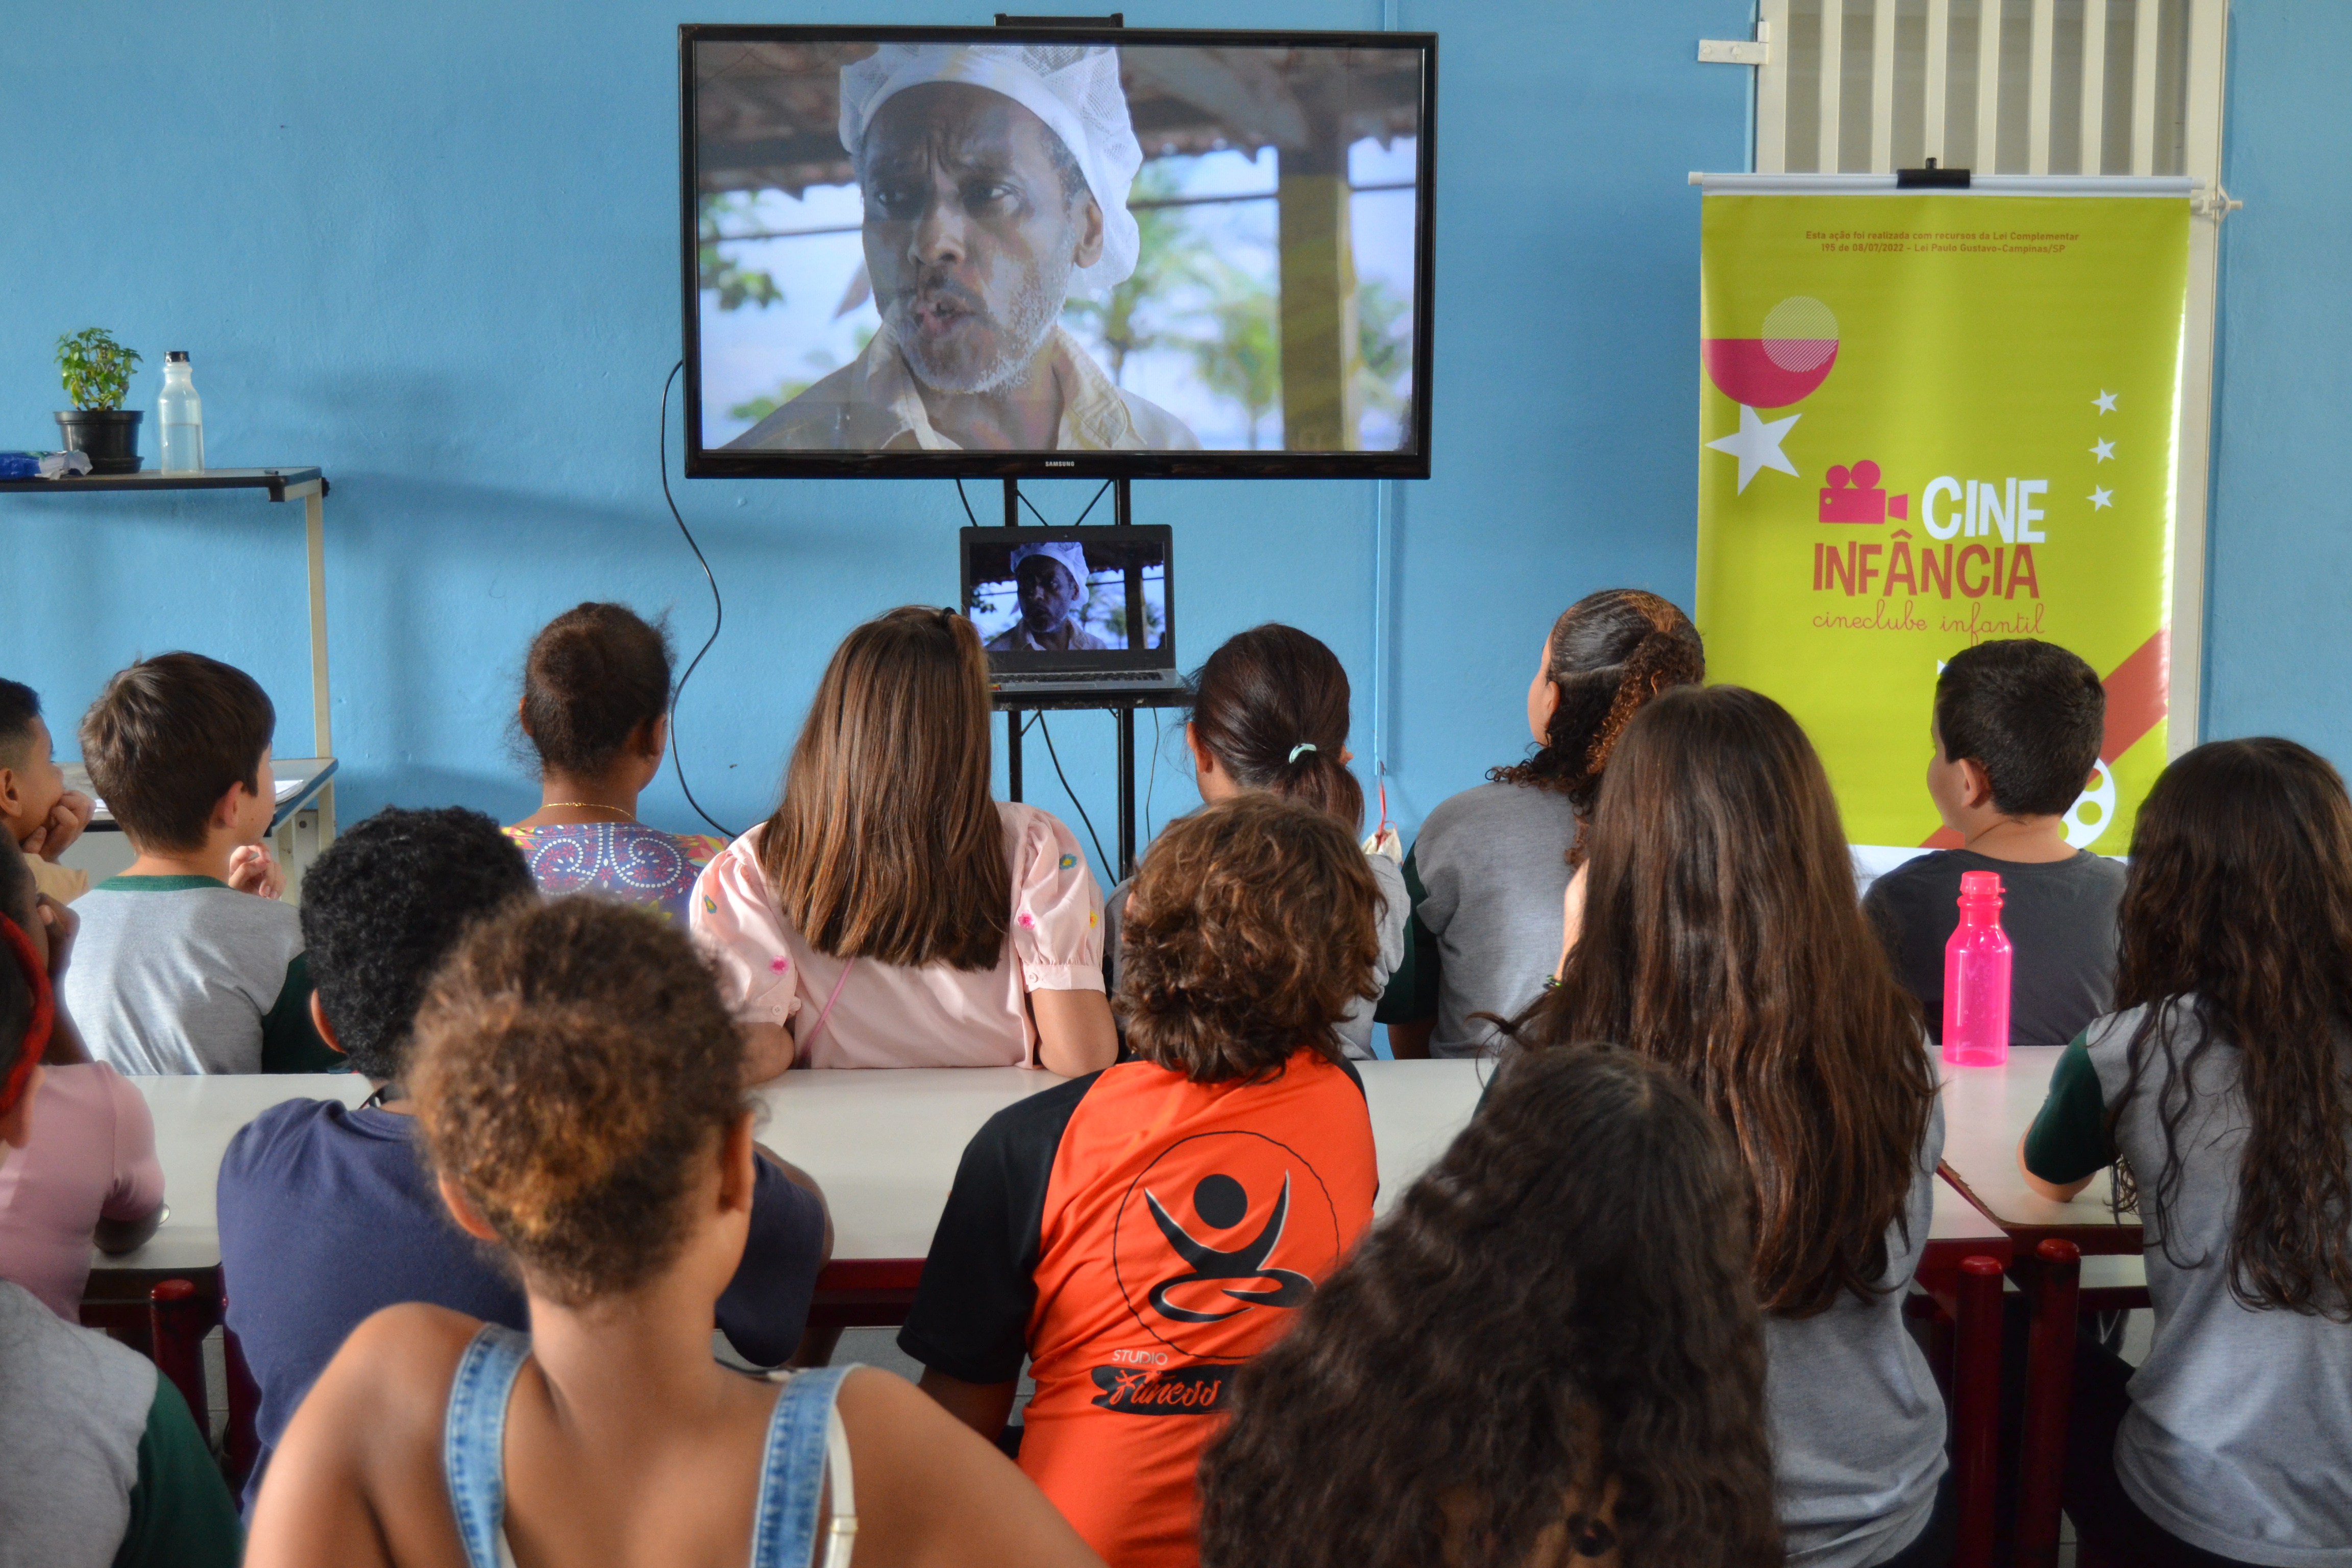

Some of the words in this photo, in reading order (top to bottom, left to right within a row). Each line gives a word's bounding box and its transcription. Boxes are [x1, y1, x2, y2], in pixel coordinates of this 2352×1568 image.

[1806, 231, 1826, 239] Esta
[1829, 231, 1850, 241] ação
[1854, 231, 1865, 239] foi
[1868, 231, 1909, 239] realizada
[1979, 232, 1990, 240] da
[2011, 232, 2079, 241] Complementar
[1853, 243, 1904, 253] 08/07/2022
[1922, 476, 2048, 544] CINE
[1813, 528, 2040, 600] INFÂNCIA
[1813, 599, 1928, 631] cineclube
[1940, 602, 2045, 647] infantil
[1113, 1349, 1168, 1365] STUDIO
